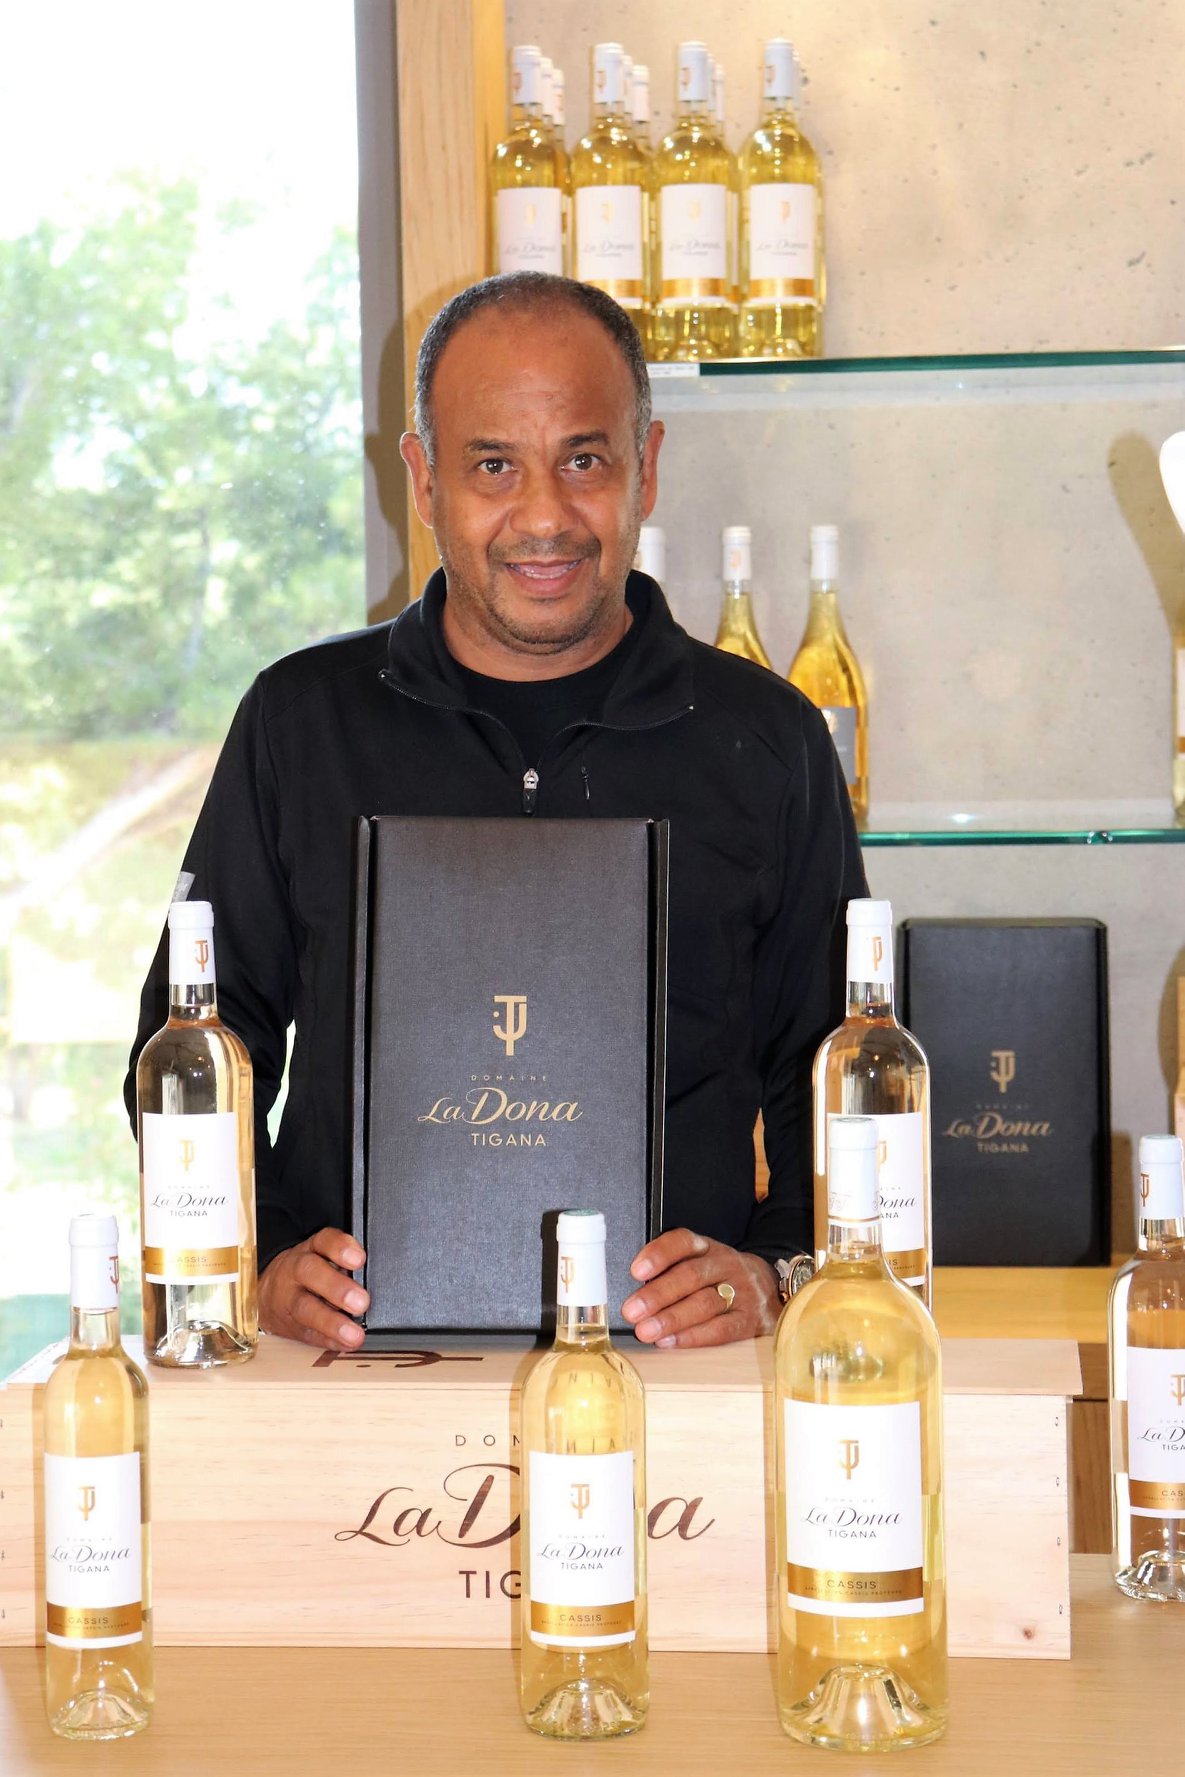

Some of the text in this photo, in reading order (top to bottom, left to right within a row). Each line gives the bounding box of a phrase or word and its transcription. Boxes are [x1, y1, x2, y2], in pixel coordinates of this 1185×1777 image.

[471, 1074, 547, 1082] DOMAINE
[417, 1087, 583, 1125] La Dona
[943, 1111, 1054, 1139] La Dona
[471, 1133, 547, 1147] TIGANA
[977, 1143, 1030, 1153] TIGANA
[175, 1191, 229, 1209] Dona
[170, 1209, 208, 1217] TIGANA
[334, 1486, 441, 1548] La
[801, 1506, 903, 1527] La Dona
[828, 1529, 877, 1539] TIGANA
[72, 1544, 131, 1563] Dona
[538, 1541, 624, 1561] La Dona
[69, 1564, 110, 1573] TIGANA
[561, 1562, 604, 1570] TIGANA
[827, 1579, 877, 1590] CASSIS
[68, 1615, 110, 1625] CASSIS
[559, 1614, 602, 1623] CASSIS
